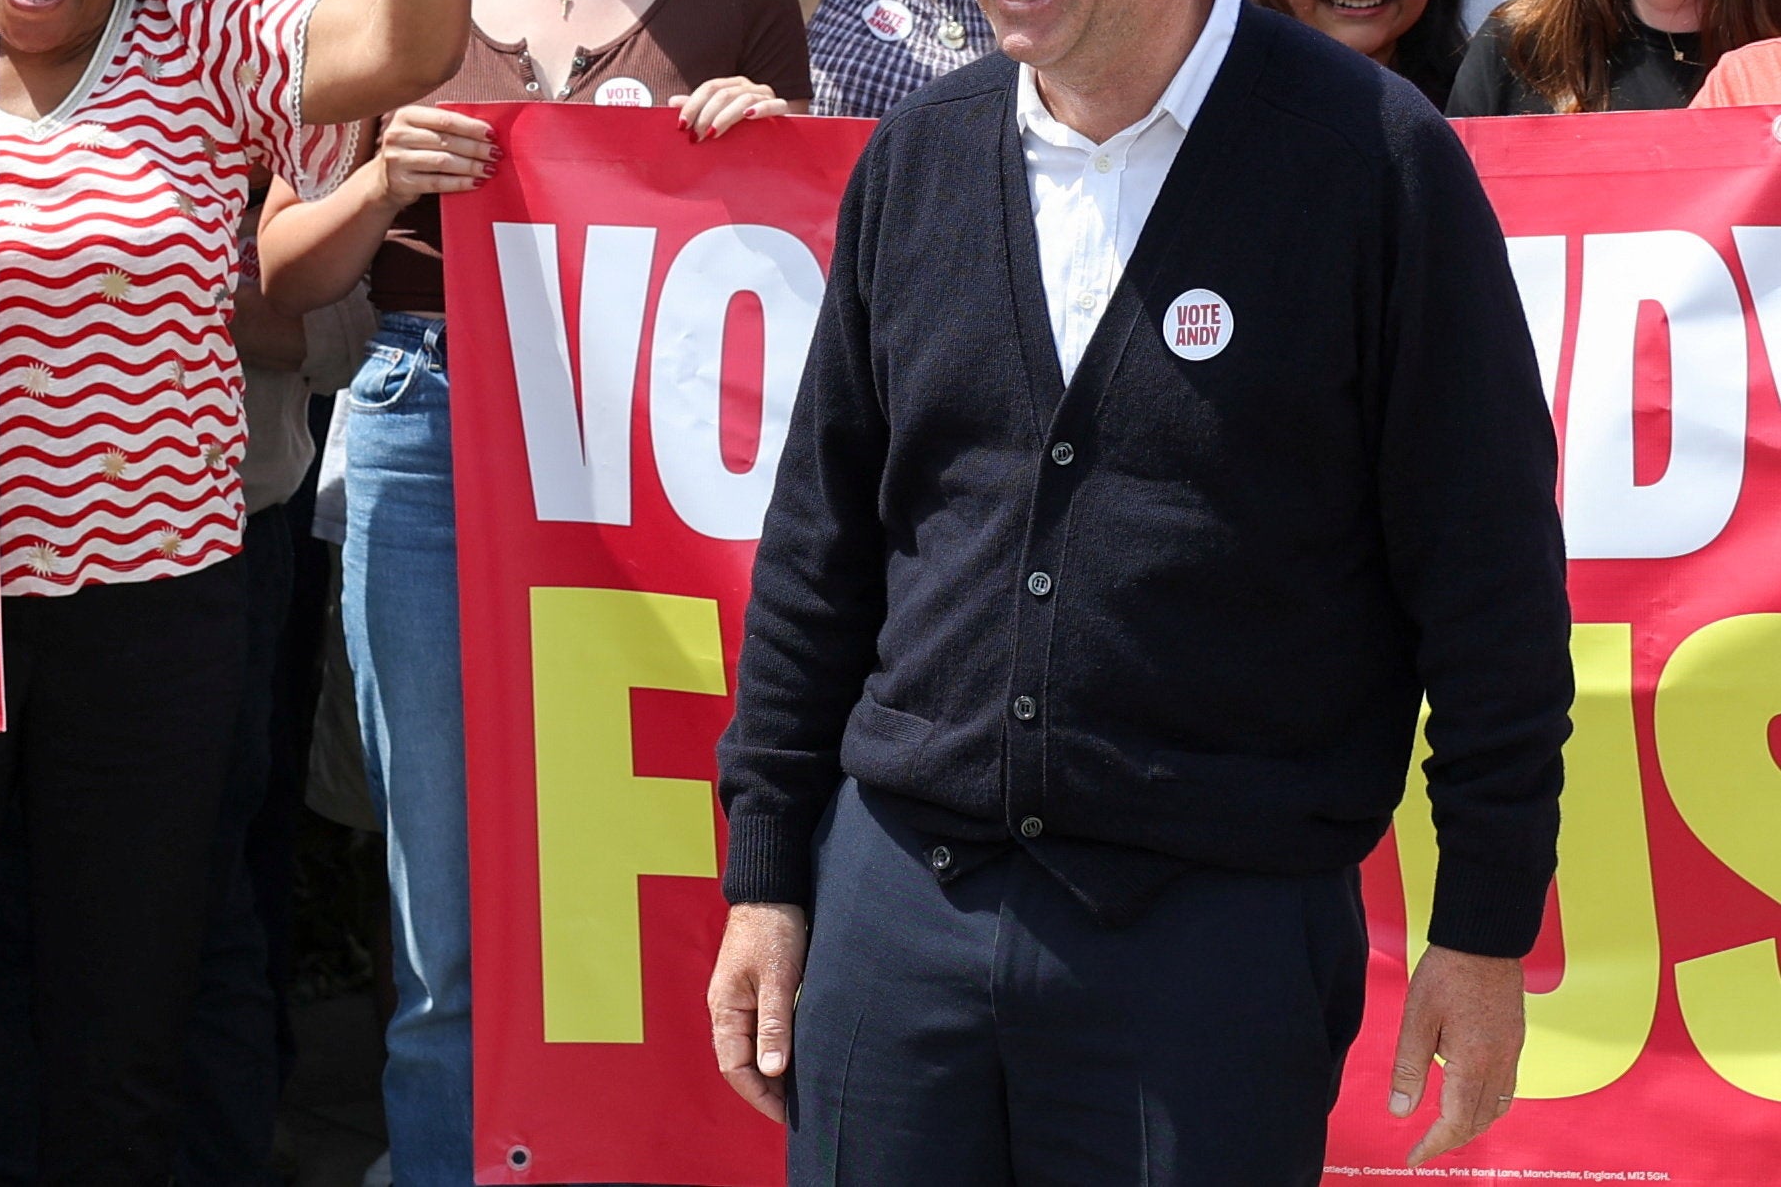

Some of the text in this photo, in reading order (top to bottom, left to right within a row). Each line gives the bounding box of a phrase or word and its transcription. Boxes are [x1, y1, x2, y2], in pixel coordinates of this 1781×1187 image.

[606, 87, 641, 100] VOTE
[1176, 304, 1221, 326] VOTE
[1175, 326, 1221, 346] ANDY
[492, 222, 826, 541] VO
[1363, 1166, 1414, 1176] Gorebrook
[1415, 1167, 1448, 1178] Works,
[1449, 1167, 1470, 1176] Pink
[1472, 1168, 1496, 1177] Bank
[1497, 1168, 1522, 1178] Lane,
[1523, 1169, 1582, 1180] Manchester,
[1583, 1170, 1626, 1182] England,
[1627, 1171, 1645, 1180] M12
